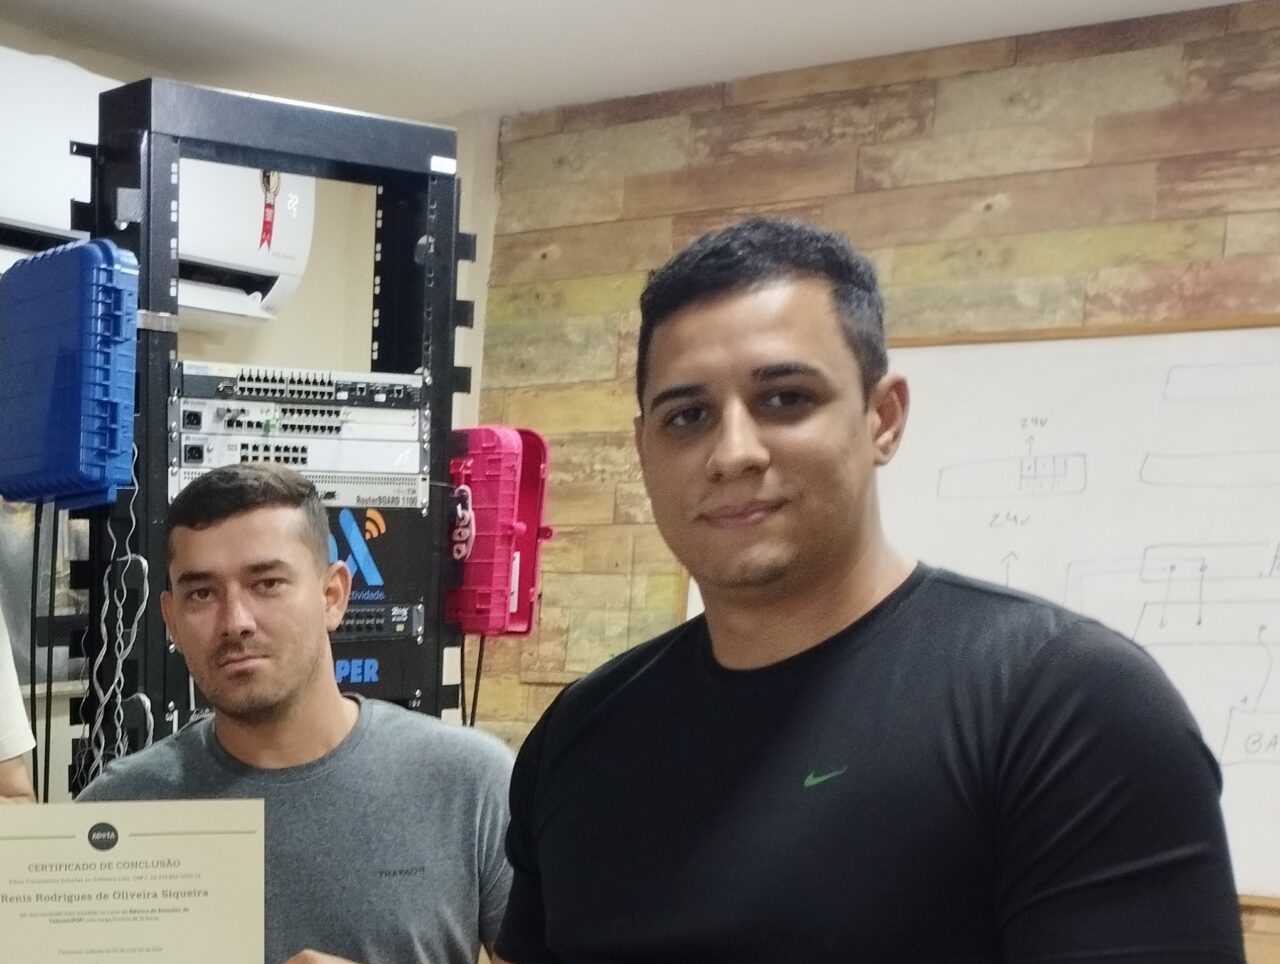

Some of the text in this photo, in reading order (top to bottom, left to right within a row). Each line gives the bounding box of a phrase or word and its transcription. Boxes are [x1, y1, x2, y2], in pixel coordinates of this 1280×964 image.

[335, 658, 379, 683] PER
[27, 858, 181, 873] CERTIFICADO DE CONCLUSÃO
[35, 892, 93, 904] Rodrigues
[95, 891, 109, 900] de
[112, 889, 158, 900] Oliveira
[161, 888, 209, 900] Siqueira
